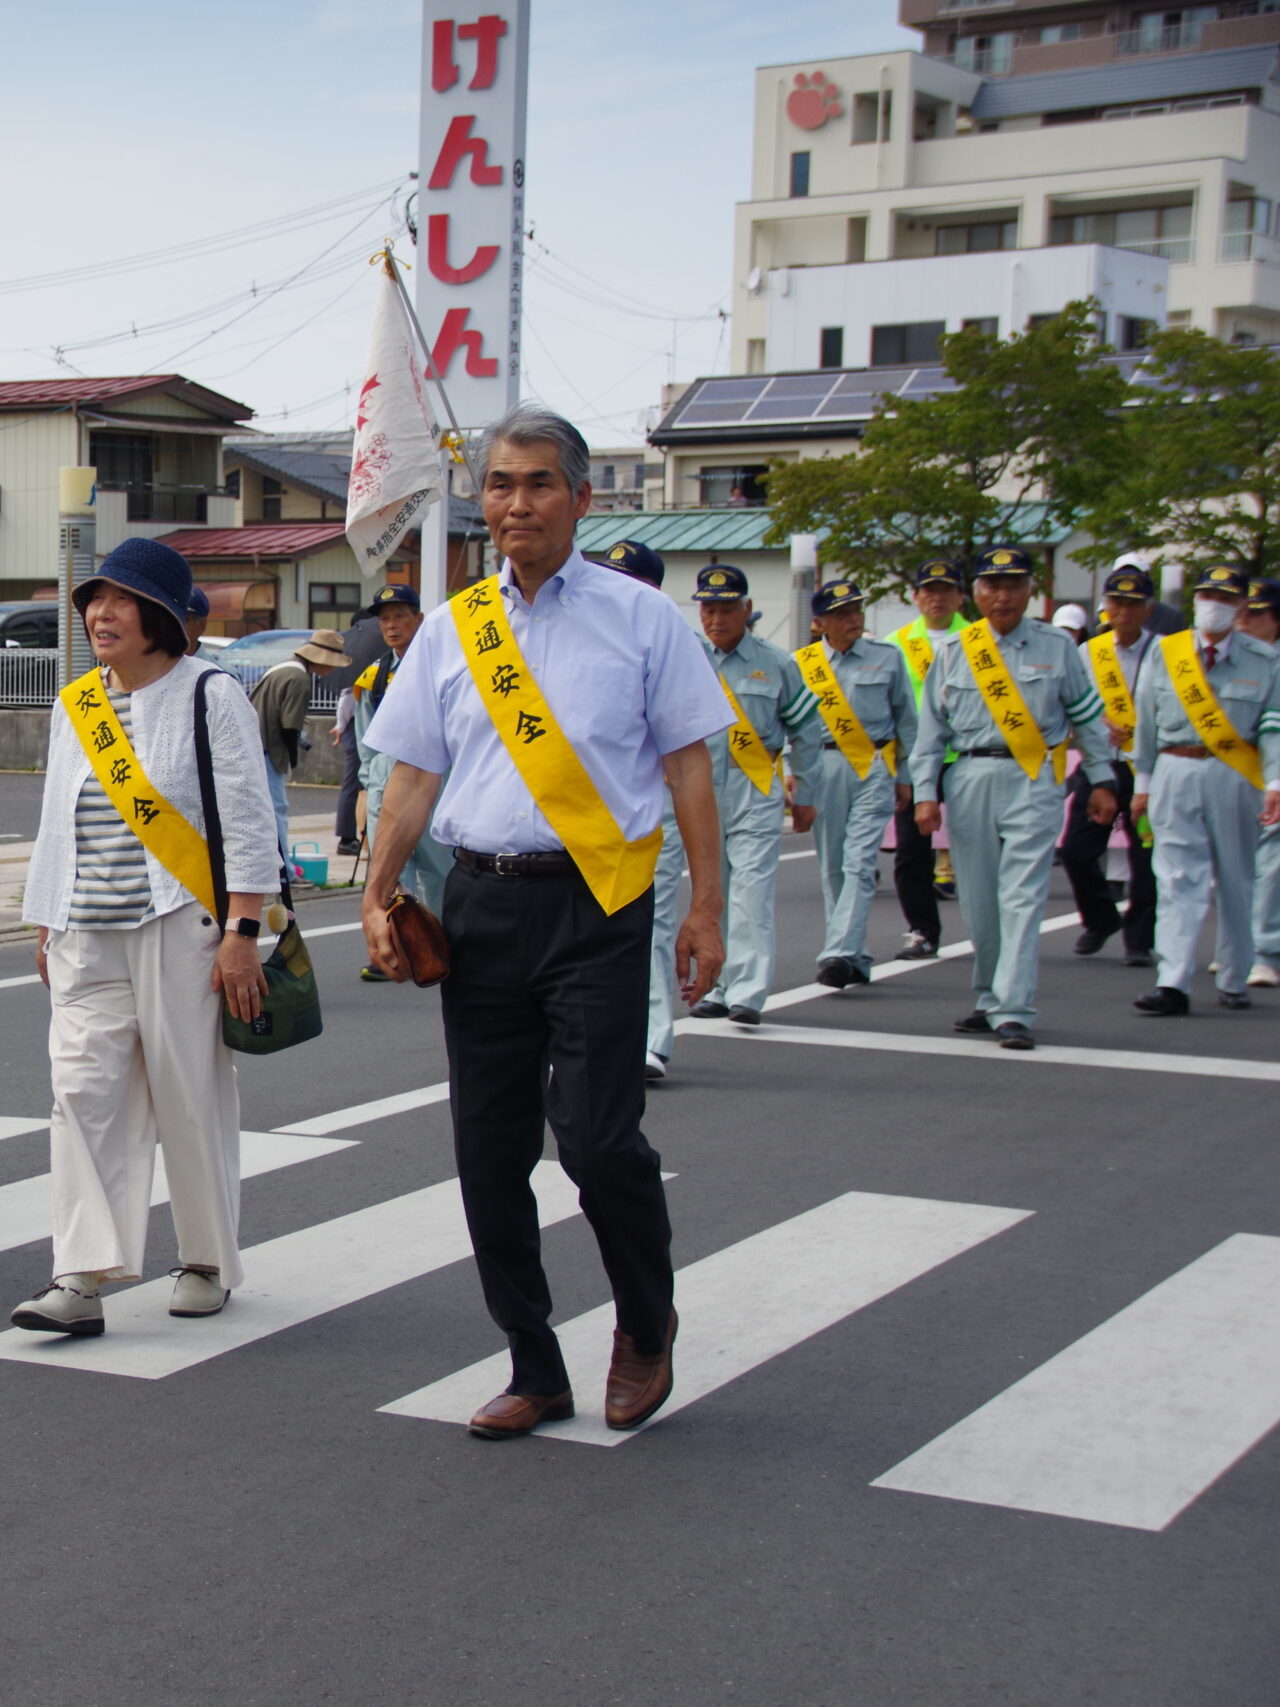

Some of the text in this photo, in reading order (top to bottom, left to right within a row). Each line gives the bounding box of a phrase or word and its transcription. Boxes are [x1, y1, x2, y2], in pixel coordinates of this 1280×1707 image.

[424, 15, 507, 380] けんしん
[464, 585, 547, 744] 交通安全
[802, 648, 854, 736] 交通安全
[968, 627, 1024, 731] 交通安全
[1175, 660, 1236, 754] 交通安全
[75, 688, 160, 826] 交通安全
